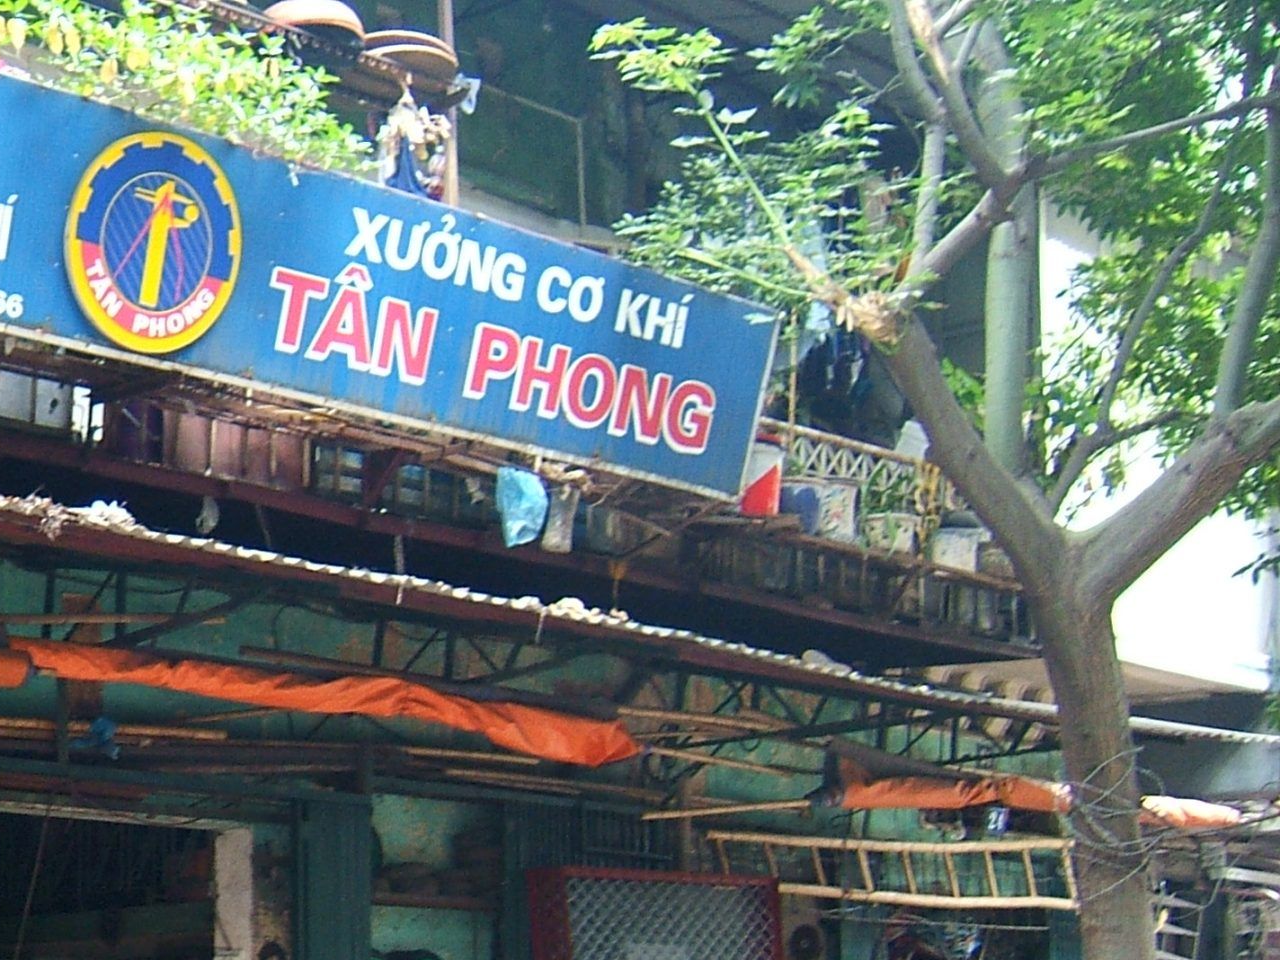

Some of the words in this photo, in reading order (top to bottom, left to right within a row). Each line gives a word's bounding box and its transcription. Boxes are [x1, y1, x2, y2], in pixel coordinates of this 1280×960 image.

[131, 287, 216, 338] PHONG
[344, 207, 527, 302] XƯỞNG
[536, 266, 605, 323] CƠ
[614, 289, 690, 349] KHÍ
[269, 262, 440, 387] TÂN
[461, 322, 717, 455] PHONG
